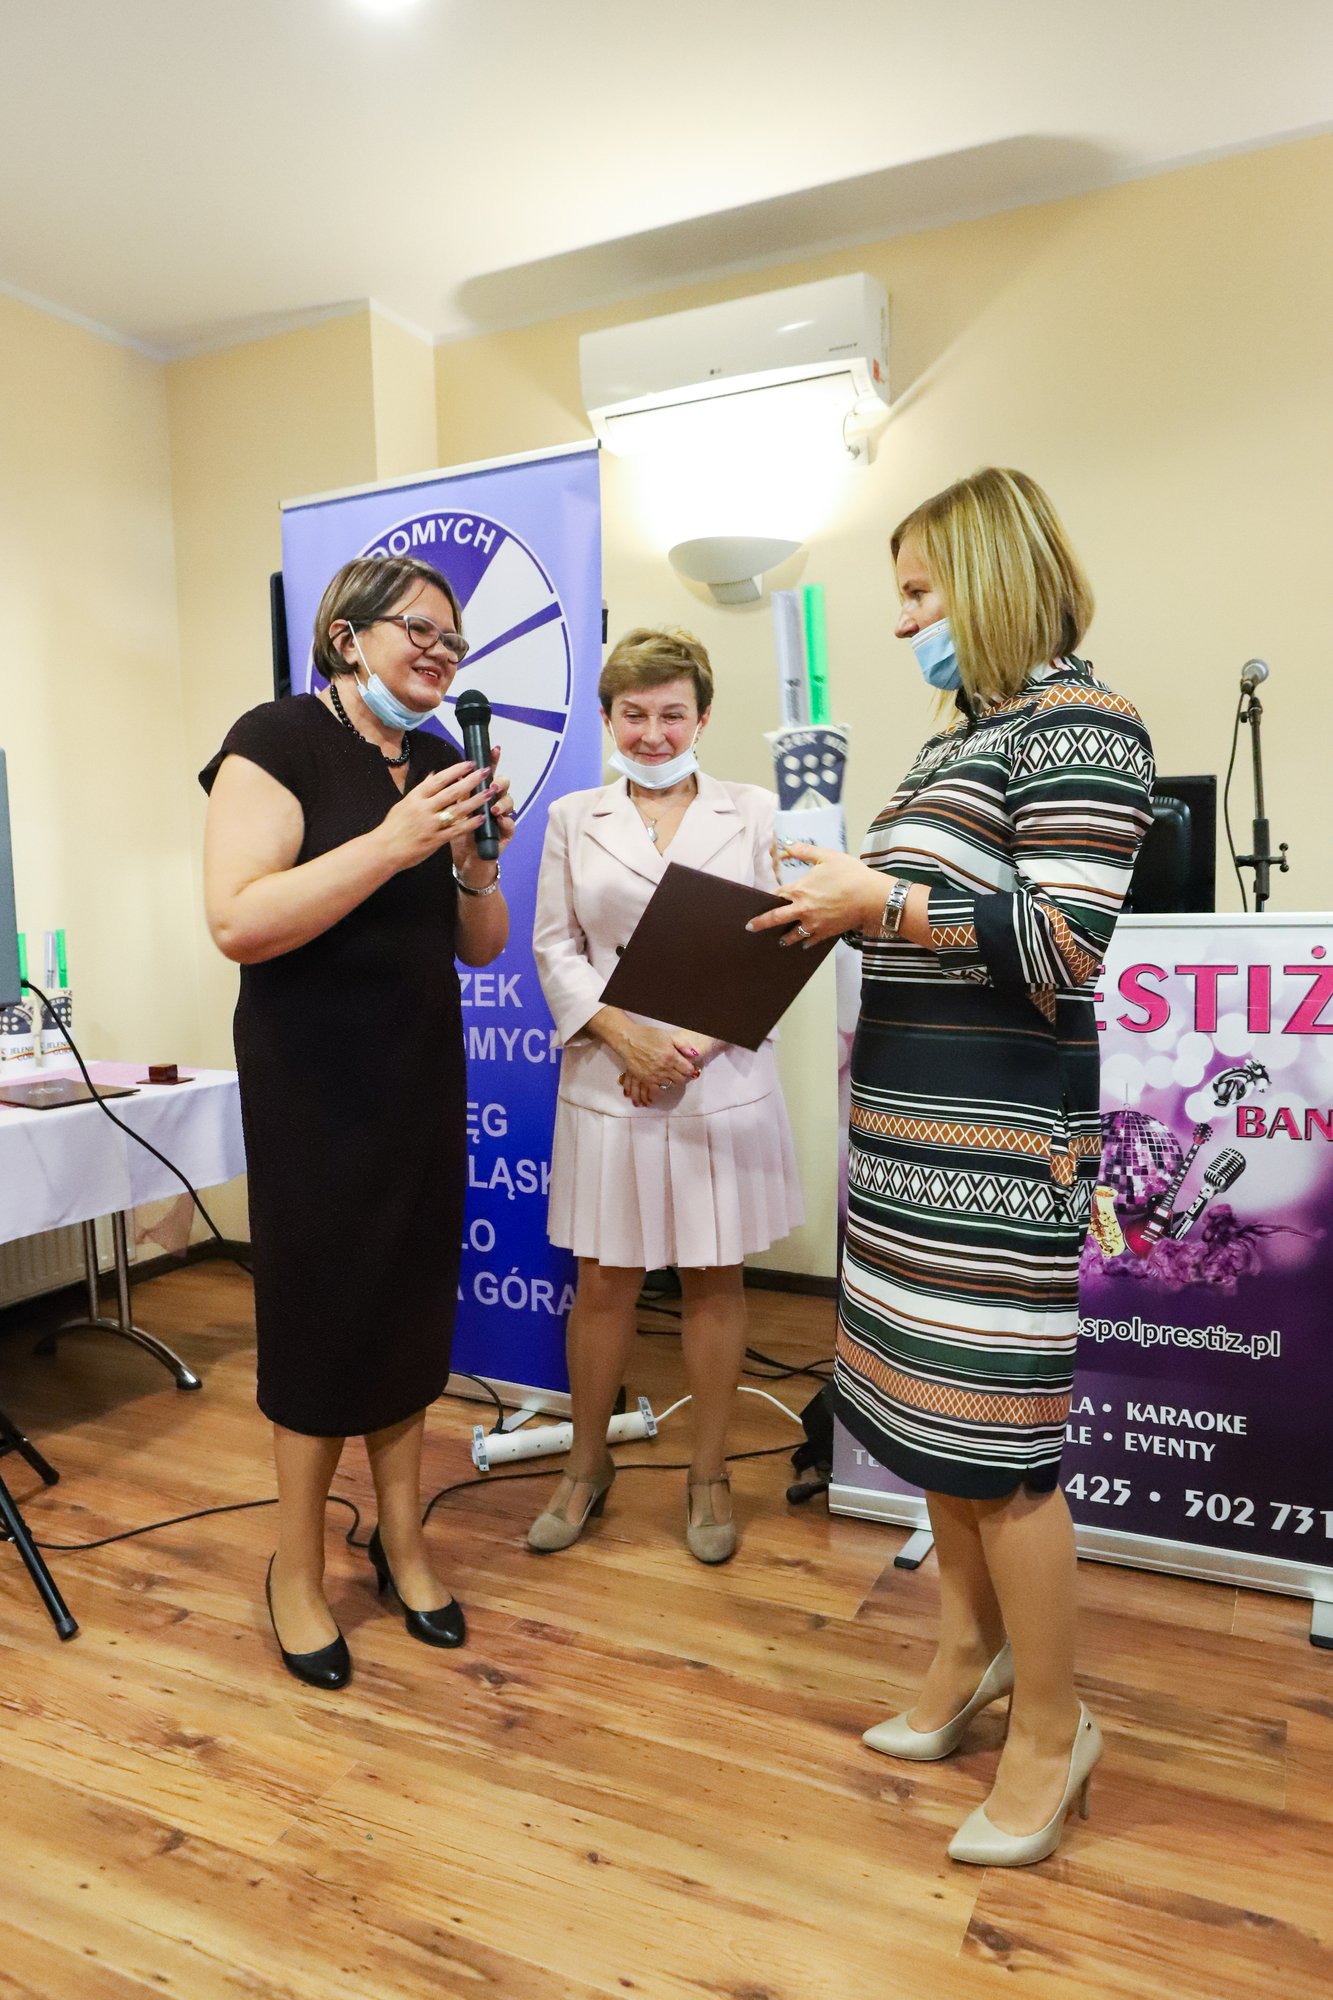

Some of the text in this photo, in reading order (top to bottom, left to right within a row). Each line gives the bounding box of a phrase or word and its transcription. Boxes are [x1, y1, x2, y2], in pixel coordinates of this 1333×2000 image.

[474, 1267, 576, 1315] GÓRA
[1078, 1316, 1280, 1359] spolprestiz.pl
[1127, 1402, 1247, 1435] KARAOKE
[1124, 1432, 1216, 1462] EVENTY
[1065, 1473, 1333, 1539] 425 502 731
